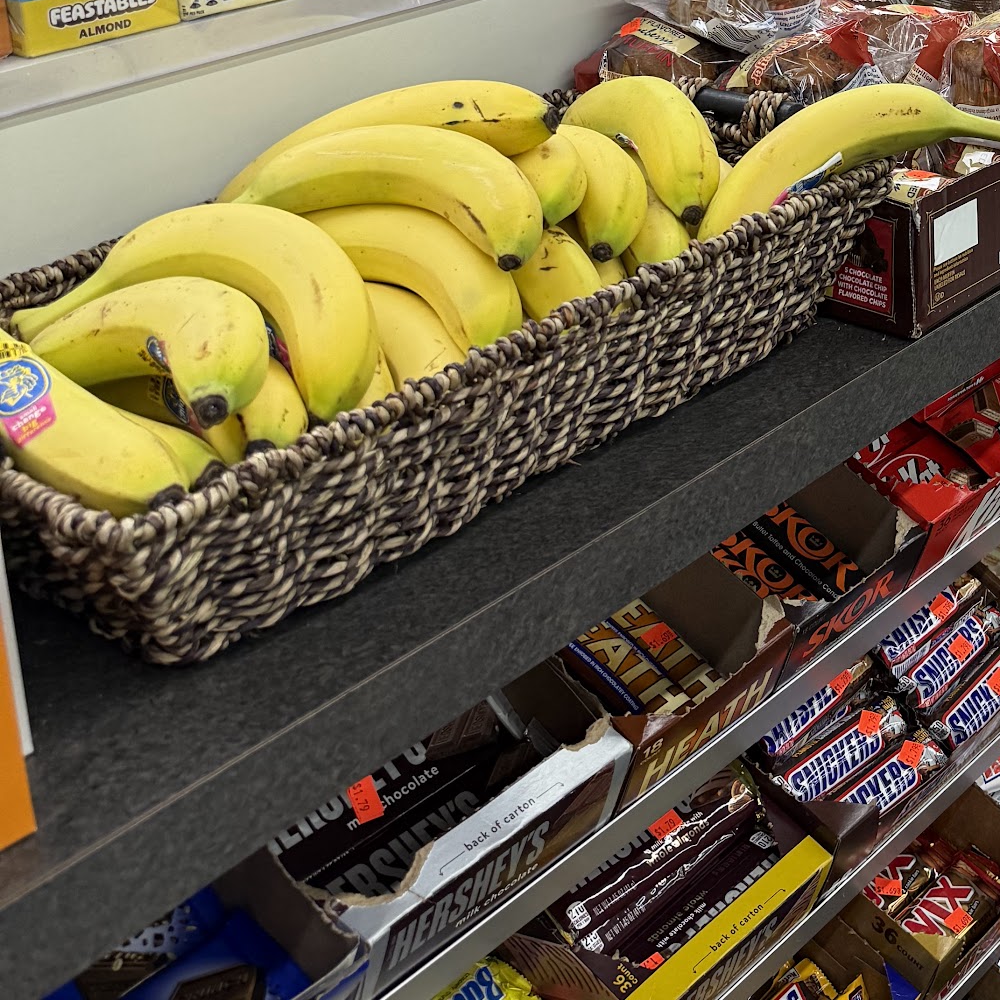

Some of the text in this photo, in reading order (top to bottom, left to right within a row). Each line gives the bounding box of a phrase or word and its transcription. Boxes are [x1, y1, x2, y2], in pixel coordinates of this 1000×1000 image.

[79, 18, 132, 39] ALMOND
[648, 18, 687, 40] FLAVORED
[838, 273, 888, 292] CHOCOLATE CHIP
[849, 267, 883, 284] CHOCOLATE
[837, 280, 888, 301] WITH CHOCOLATE
[838, 289, 887, 309] FLAVORED CHIPS
[802, 570, 896, 657] SKOR
[638, 668, 774, 798] HEATH
[351, 781, 371, 814] $1.79
[381, 765, 441, 810] chocolate
[463, 796, 537, 852] back of carton
[654, 817, 677, 836] $1.79
[388, 820, 552, 970] HERSHEY'S
[455, 862, 539, 929] milk chocolate
[709, 904, 765, 953] back of carton
[871, 915, 899, 945] 36
[897, 944, 925, 971] COUNT
[617, 963, 639, 985] count
